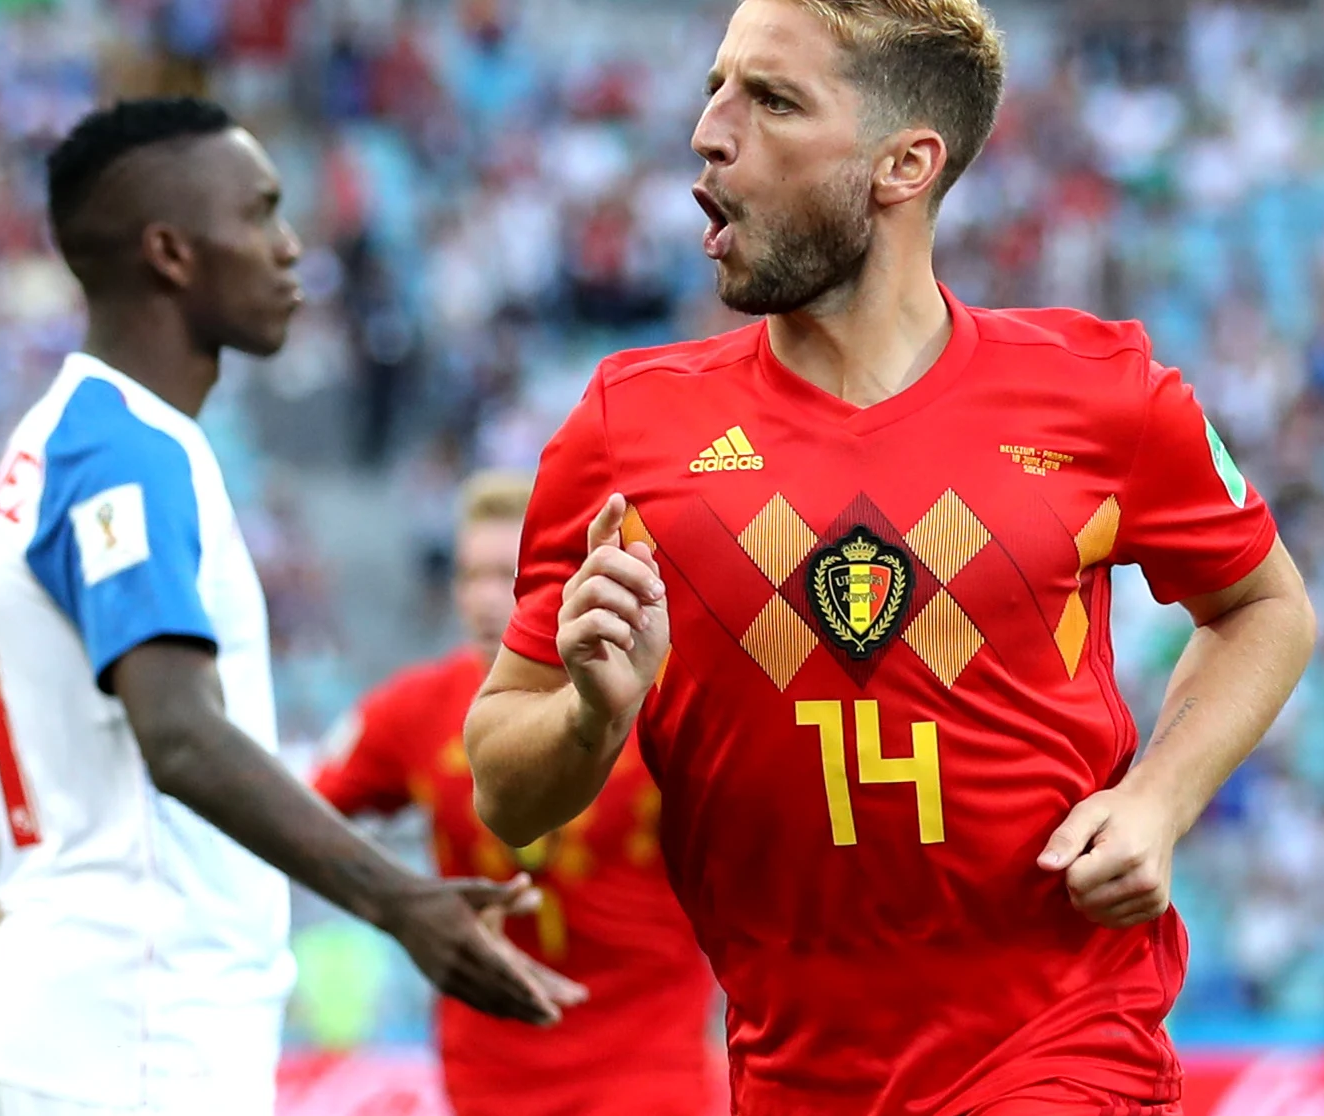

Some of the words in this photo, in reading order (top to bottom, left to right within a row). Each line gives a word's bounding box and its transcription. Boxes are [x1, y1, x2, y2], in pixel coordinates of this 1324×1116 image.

[999, 445, 1036, 456] BELGIUM
[689, 454, 765, 472] adidas
[795, 700, 945, 846] 14
